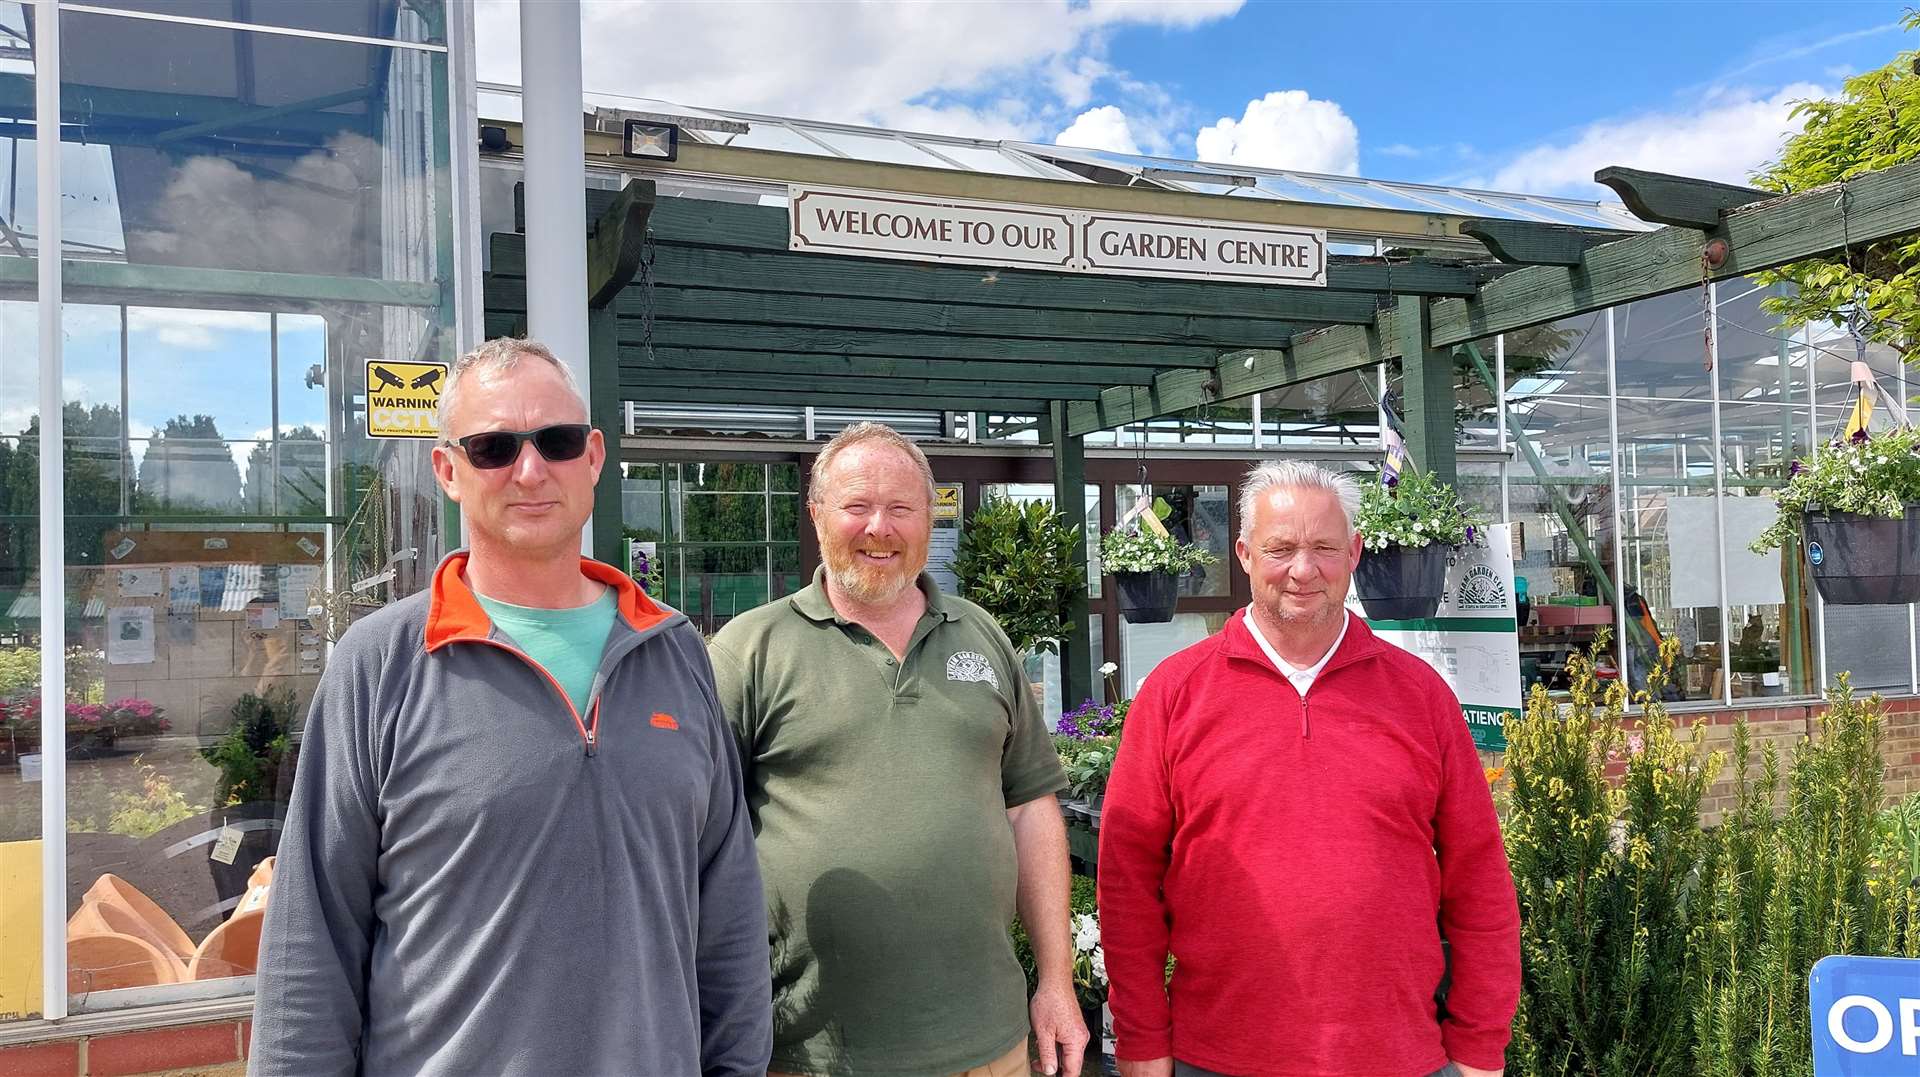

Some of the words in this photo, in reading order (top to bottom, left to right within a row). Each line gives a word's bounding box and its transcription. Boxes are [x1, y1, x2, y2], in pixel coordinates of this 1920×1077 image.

[815, 207, 953, 242] WELCOME
[958, 220, 995, 246] TO
[1001, 223, 1057, 250] OUR
[1099, 230, 1207, 262] GARDEN
[1217, 239, 1309, 269] CENTRE
[1462, 709, 1504, 726] ATIENC
